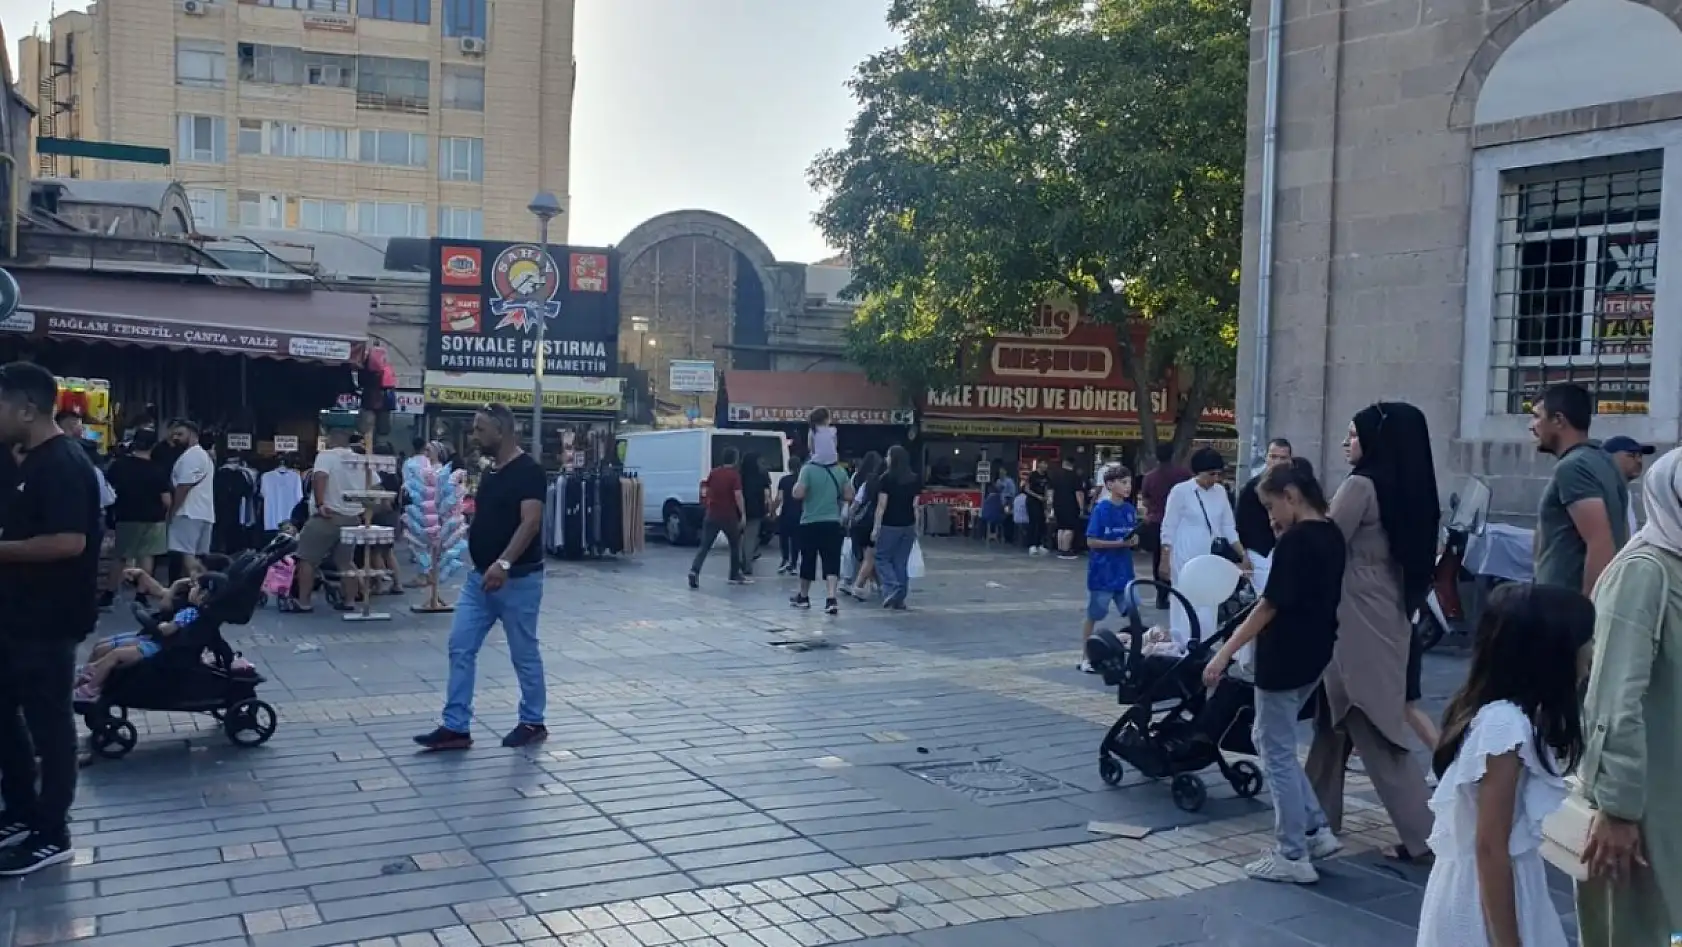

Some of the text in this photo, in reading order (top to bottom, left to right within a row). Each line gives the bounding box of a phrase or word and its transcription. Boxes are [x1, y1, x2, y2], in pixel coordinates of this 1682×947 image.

[49, 316, 109, 332] SAĞLAM
[112, 323, 173, 338] TEKSTİL
[184, 330, 228, 344] ÇANTA
[240, 335, 279, 348] VALİZ
[441, 334, 516, 353] SOYKALE
[441, 354, 518, 368] PASTIRMACI
[927, 384, 1168, 413] KALE TURŞU VE DÖNERCSİ
